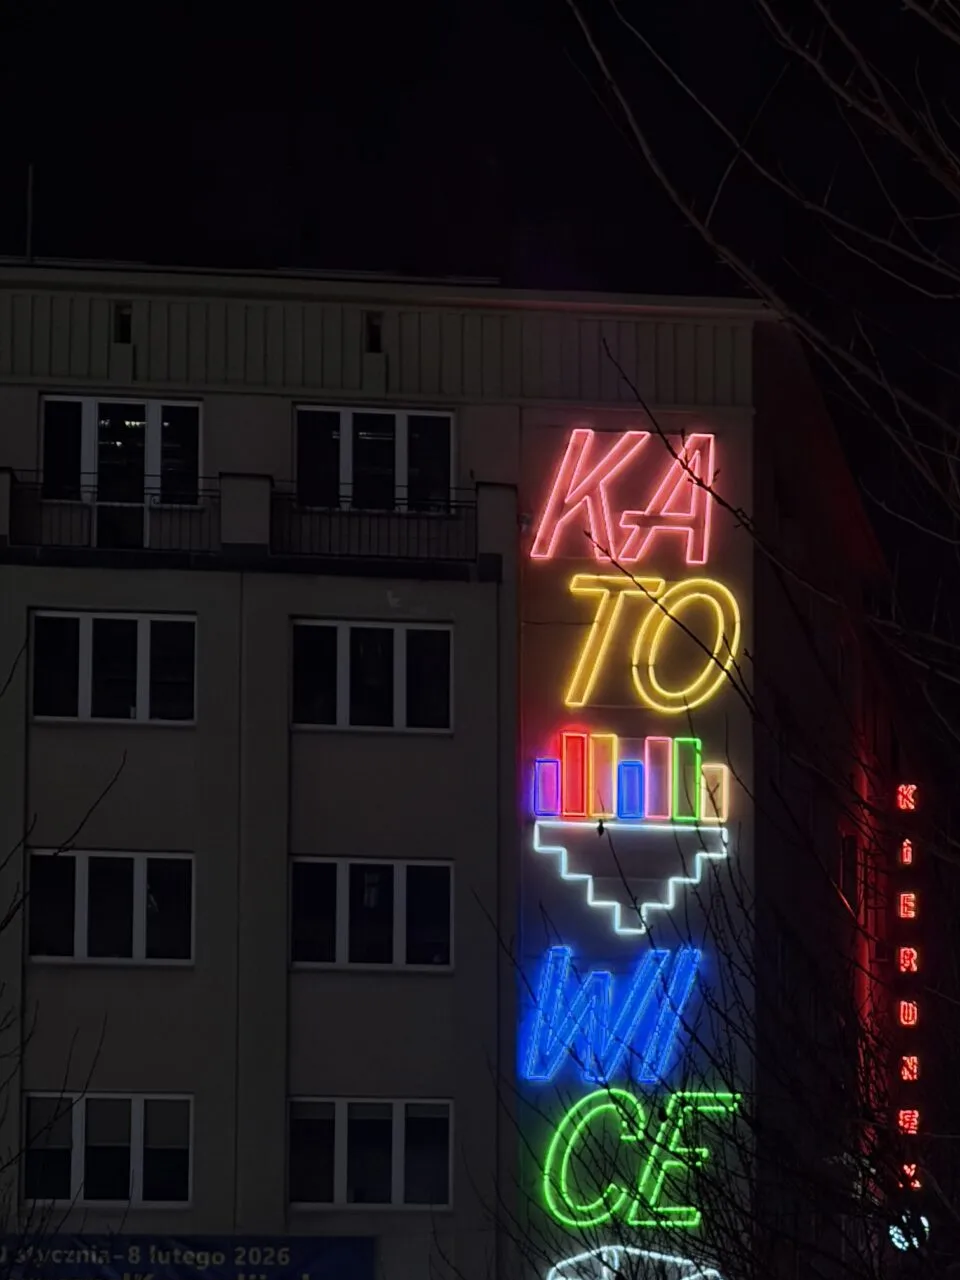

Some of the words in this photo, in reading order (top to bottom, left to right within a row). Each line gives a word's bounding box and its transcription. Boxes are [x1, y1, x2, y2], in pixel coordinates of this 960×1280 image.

[530, 428, 715, 564] KA
[565, 574, 741, 714] TO
[521, 945, 702, 1085] WI
[543, 1088, 742, 1228] CE
[151, 1244, 226, 1270] lutego
[234, 1246, 291, 1266] 2026
